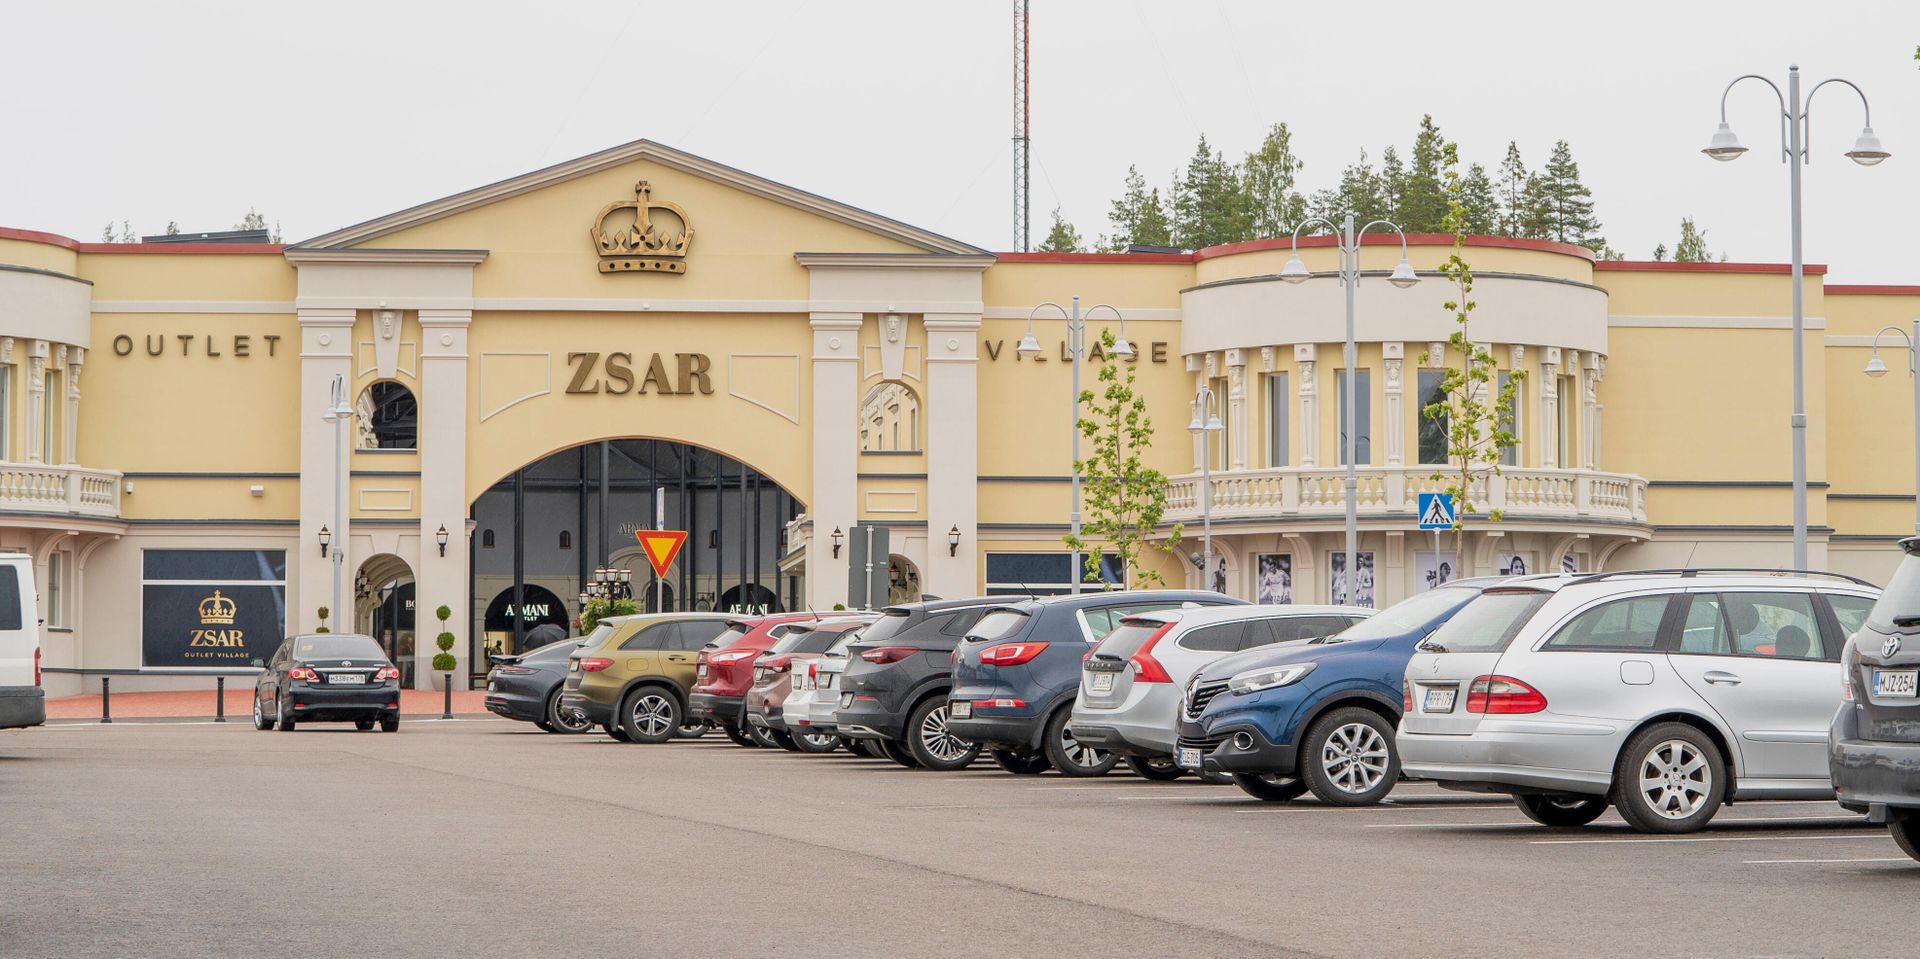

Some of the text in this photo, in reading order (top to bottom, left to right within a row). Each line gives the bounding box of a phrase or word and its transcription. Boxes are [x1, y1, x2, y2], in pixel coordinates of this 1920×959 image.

[113, 334, 281, 357] OUTLET
[565, 351, 715, 395] ZSAR
[505, 604, 549, 616] AMANI
[190, 629, 245, 647] ZSAR
[1879, 674, 1914, 693] MJZ-254
